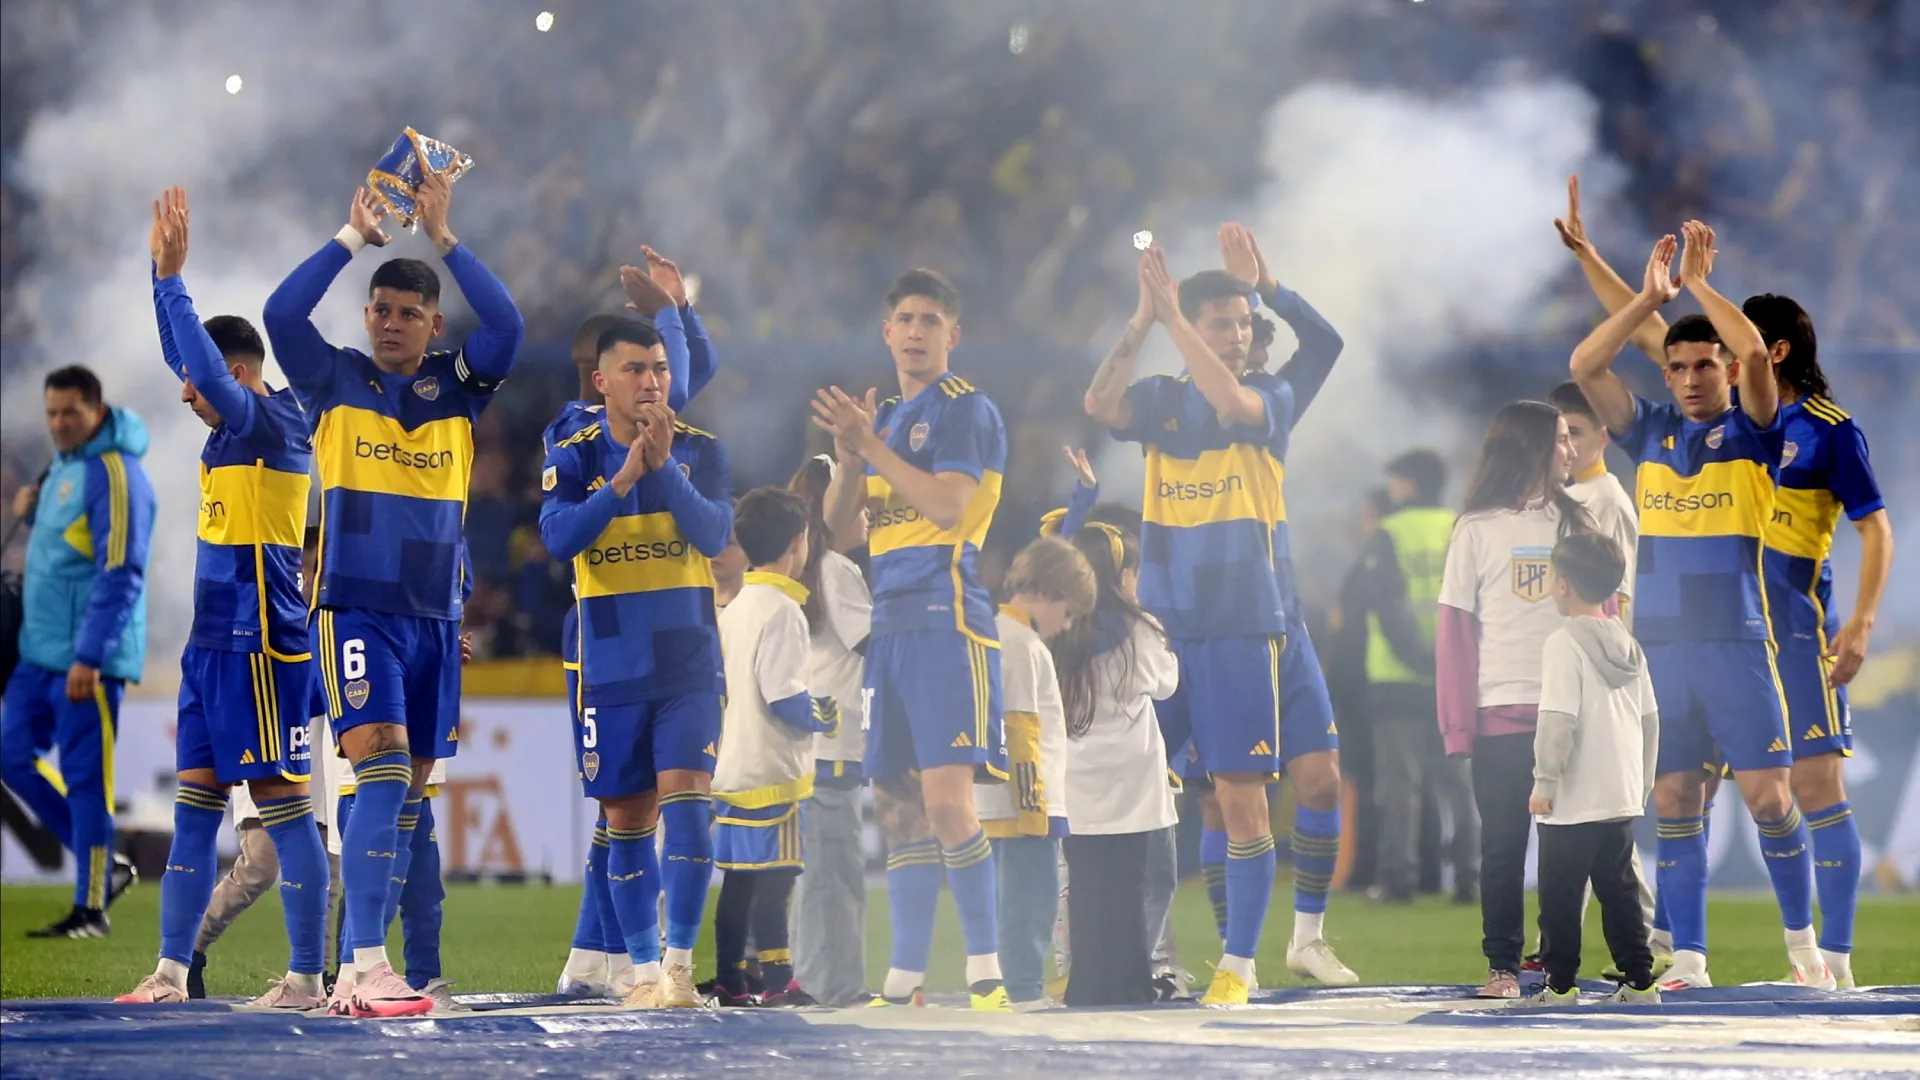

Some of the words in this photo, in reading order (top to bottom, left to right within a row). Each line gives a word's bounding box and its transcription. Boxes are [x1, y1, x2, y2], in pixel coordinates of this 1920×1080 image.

[355, 436, 454, 469] betsson
[1158, 473, 1242, 501] betsson
[1643, 489, 1734, 513] betsson
[1518, 564, 1548, 597] LPF
[343, 638, 366, 680] 6
[583, 707, 597, 749] 5
